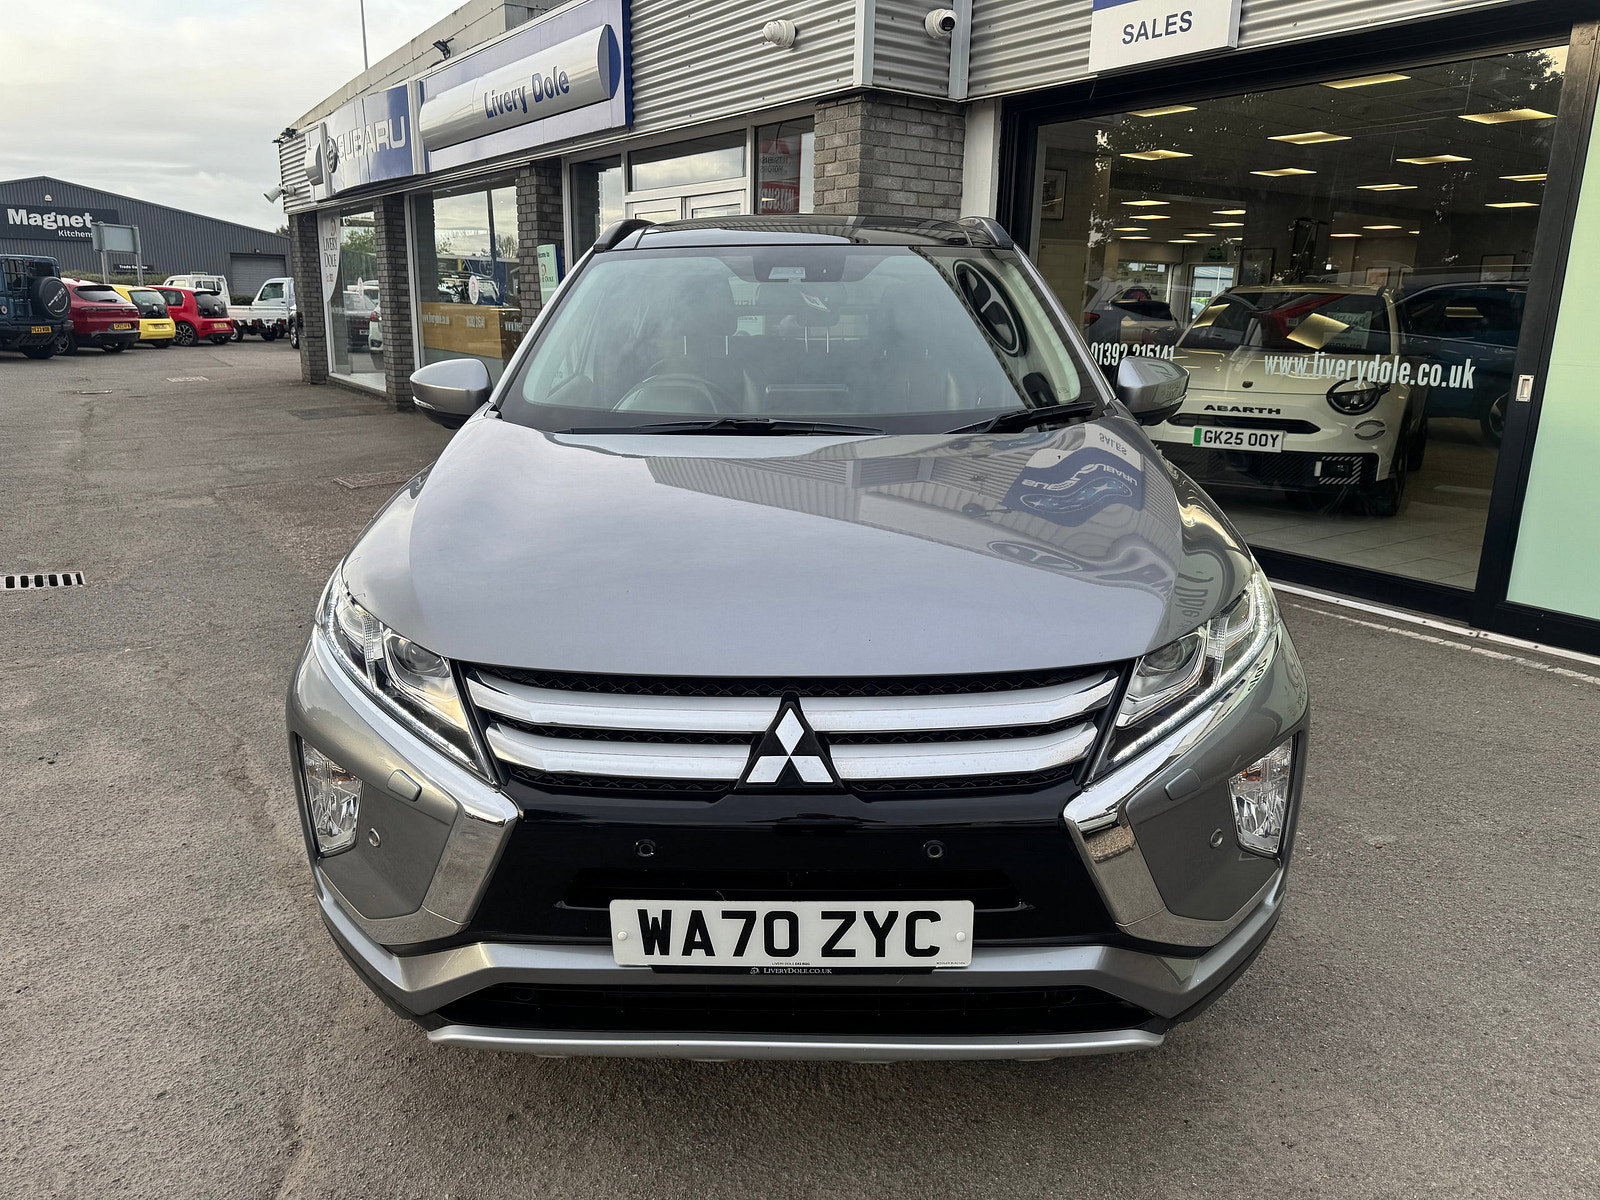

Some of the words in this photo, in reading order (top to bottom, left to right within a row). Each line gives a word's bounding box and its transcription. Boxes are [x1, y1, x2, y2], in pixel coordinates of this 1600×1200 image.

[1121, 10, 1193, 45] SALES
[484, 86, 528, 119] Livery
[531, 65, 570, 103] Dole
[336, 116, 406, 162] SUBARU
[7, 208, 93, 230] Magnet
[1090, 341, 1129, 367] 01392
[1264, 351, 1476, 390] www.liverydole.co.uk
[1203, 404, 1281, 415] ABARTH
[1203, 430, 1244, 446] GK25
[637, 908, 800, 958] WA70
[820, 909, 942, 958] ZYC
